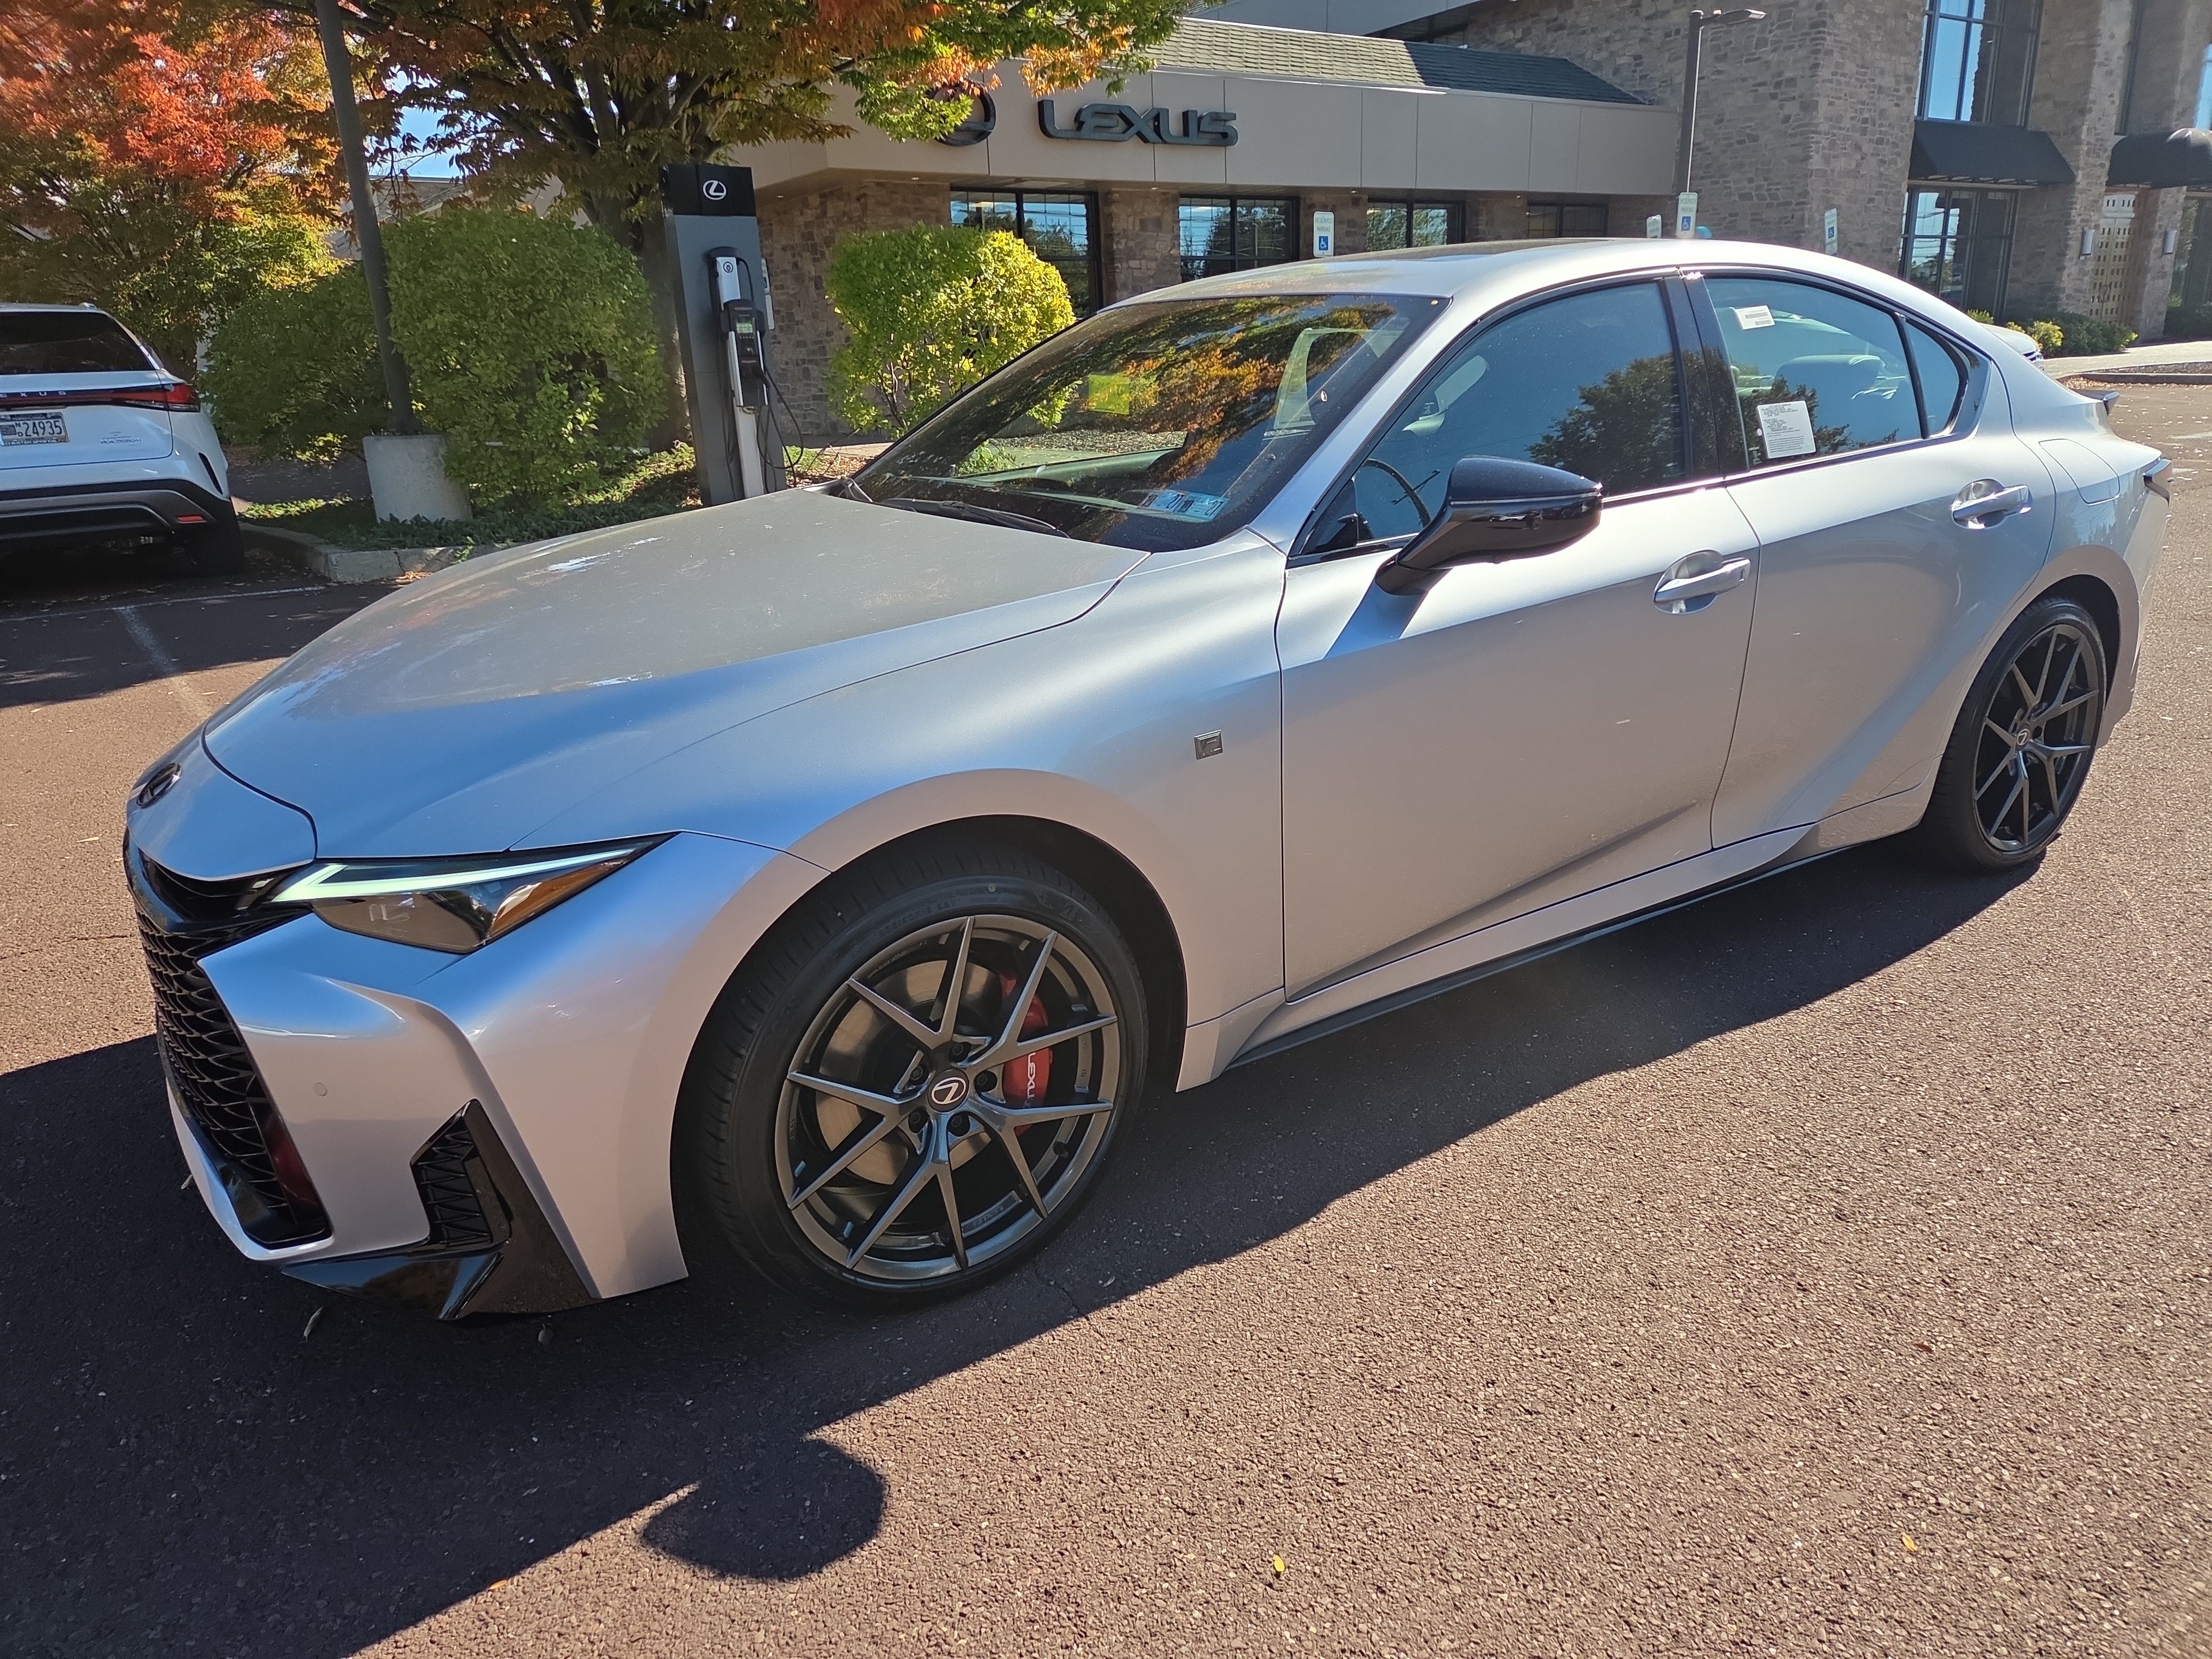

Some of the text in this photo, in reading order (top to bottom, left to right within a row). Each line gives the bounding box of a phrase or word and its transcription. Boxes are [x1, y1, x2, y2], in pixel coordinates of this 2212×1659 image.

[1037, 99, 1239, 146] LEXUS
[22, 420, 63, 437] 24935
[1178, 499, 1224, 517] 10 27
